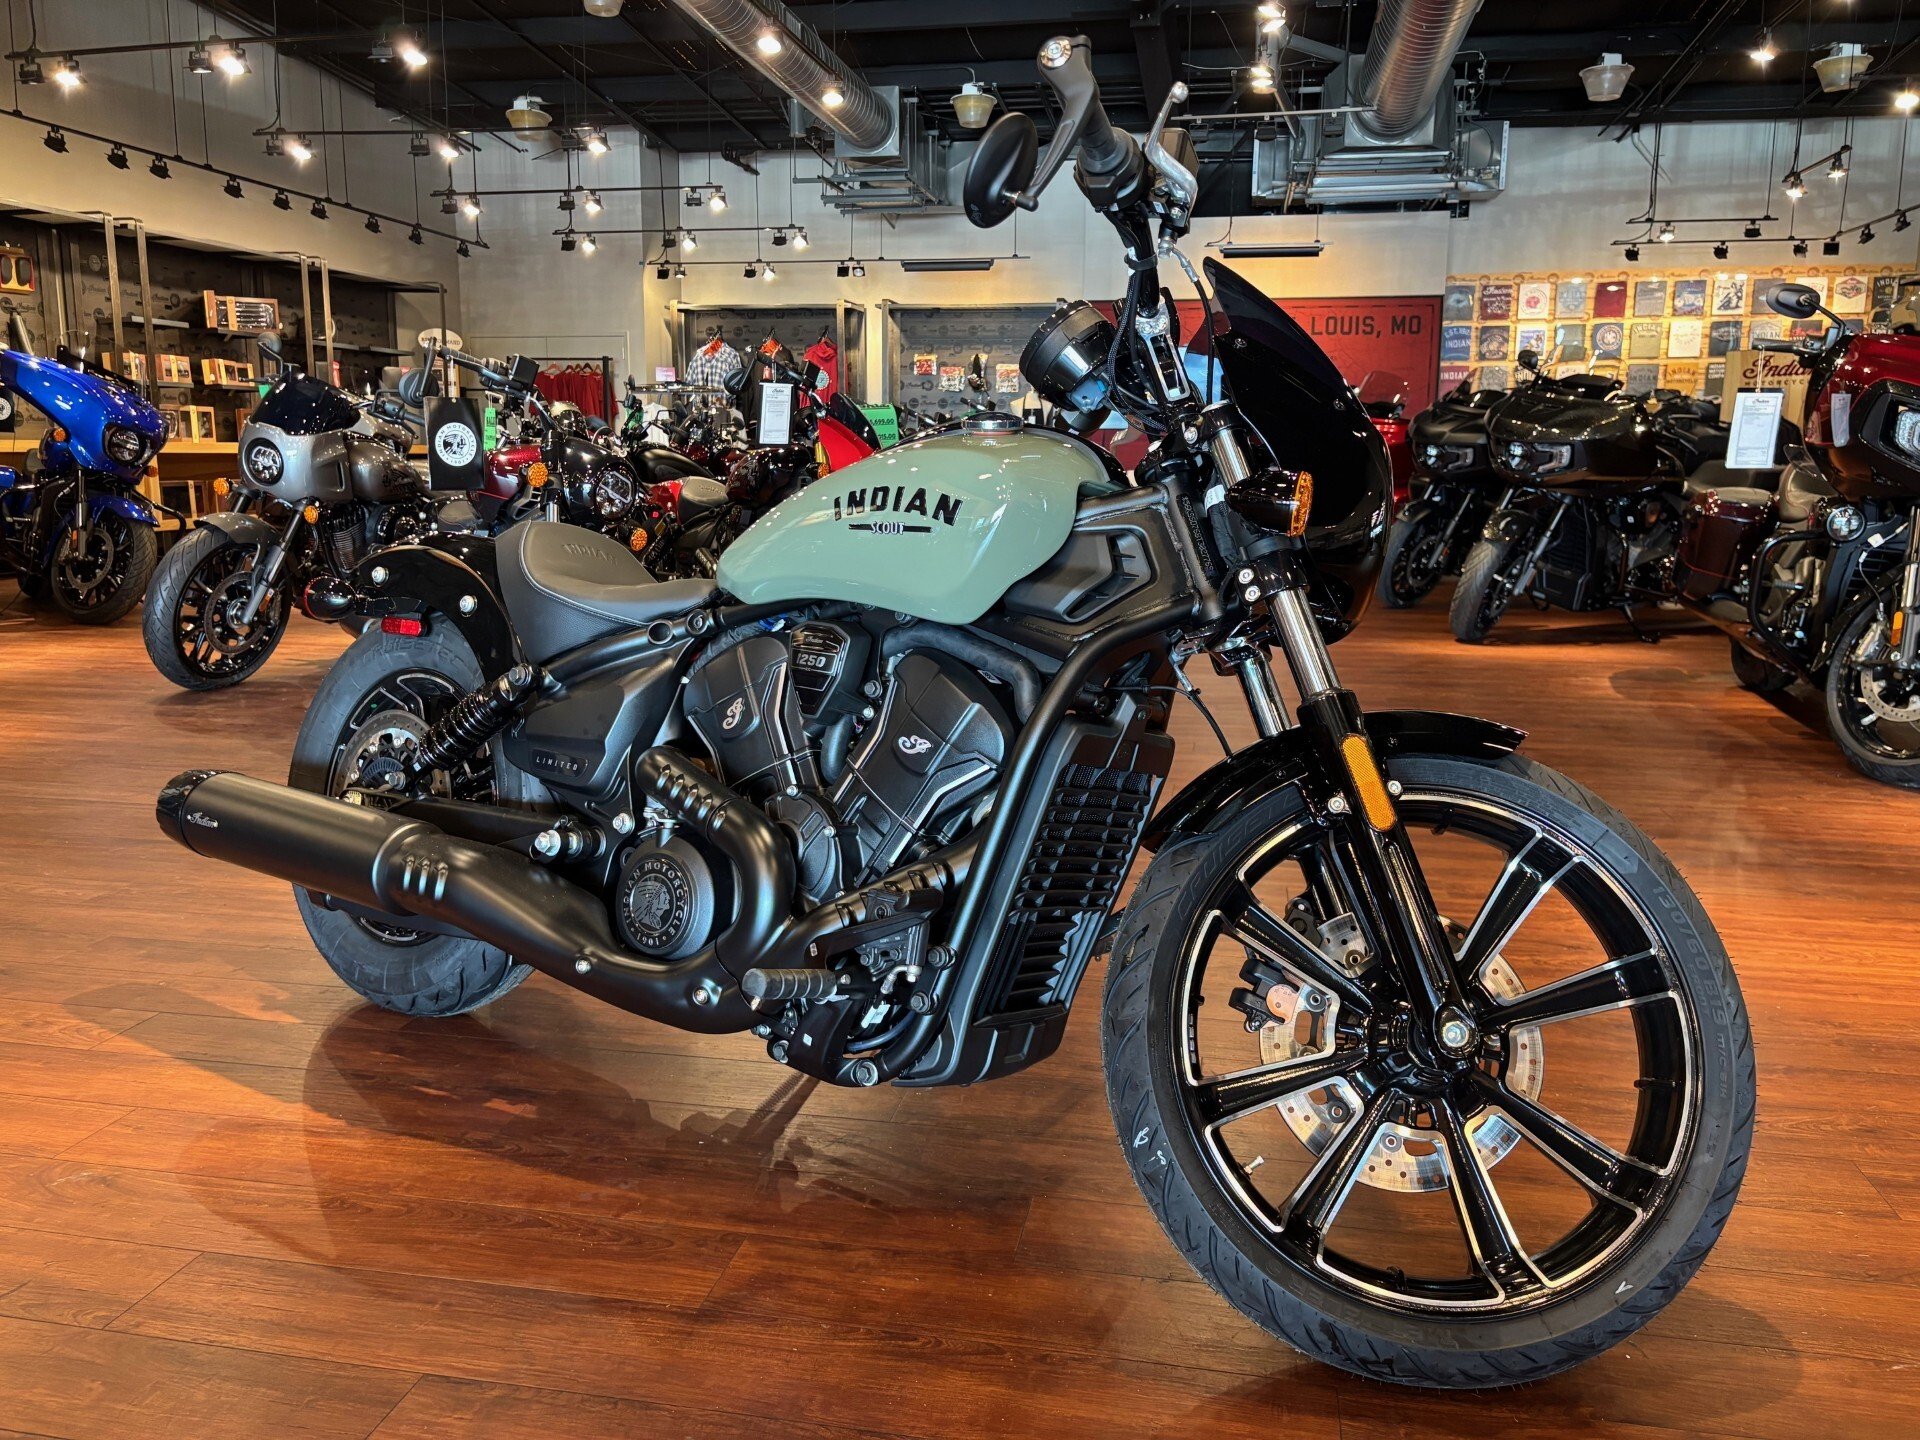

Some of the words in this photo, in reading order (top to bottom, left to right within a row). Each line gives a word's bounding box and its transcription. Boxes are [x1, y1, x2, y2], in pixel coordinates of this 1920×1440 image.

[1310, 316, 1381, 339] LOUIS,
[1390, 315, 1422, 335] MO
[1742, 354, 1813, 379] India
[1744, 379, 1804, 387] MOTORCYC
[833, 485, 963, 526] INDIAN
[870, 520, 905, 535] SCOUT
[796, 653, 827, 668] 1250
[536, 756, 578, 771] LIMITED
[623, 869, 641, 923] INDIAN
[644, 861, 685, 936] MOTORCYCLE
[1653, 886, 1709, 971] 130/60
[637, 934, 660, 946] 1901
